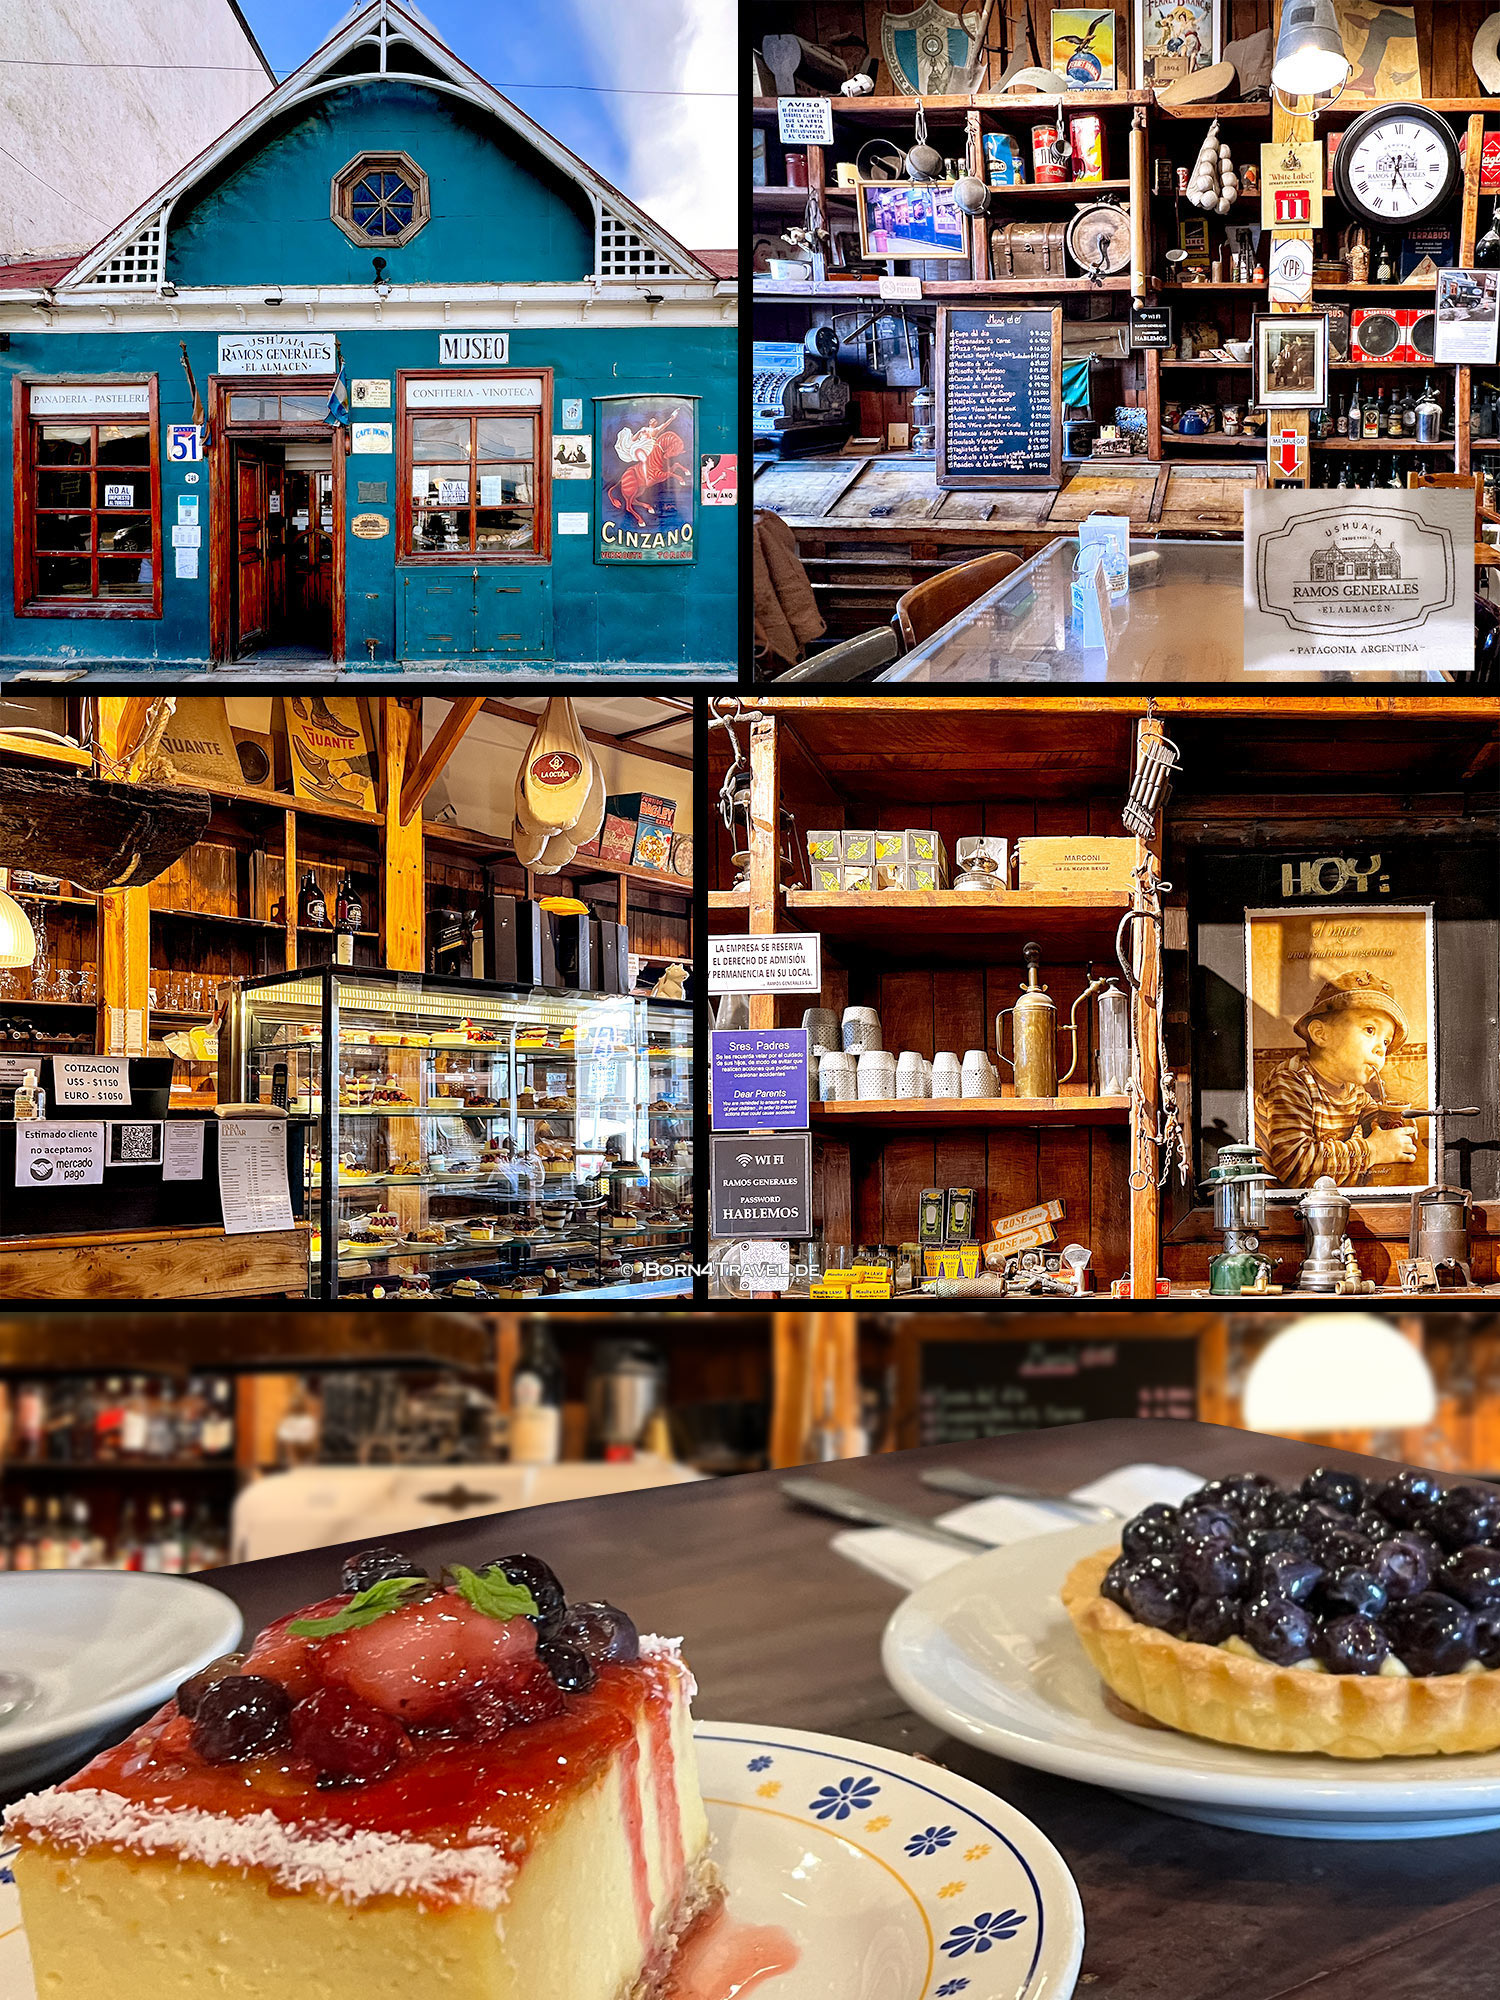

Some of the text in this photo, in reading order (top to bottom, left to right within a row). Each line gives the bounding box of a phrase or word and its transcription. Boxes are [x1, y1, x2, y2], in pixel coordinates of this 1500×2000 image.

[1281, 200, 1304, 220] 11
[1408, 231, 1450, 239] TERRABUSI
[1283, 260, 1300, 276] YPF
[248, 336, 304, 347] USHUAIA
[222, 347, 331, 361] RAMOS GENERALES
[444, 338, 504, 359] MUSEO
[261, 362, 308, 371] ALMACEN
[413, 388, 534, 398] CONFITERIA VINOTECA
[34, 395, 87, 404] PANADERIA
[173, 434, 197, 459] 51
[602, 521, 693, 549] CINZANO
[1325, 522, 1382, 537] USHUAIA
[1293, 584, 1419, 598] RAMOS GENERALES
[1297, 644, 1418, 655] PATAGONIA ARGENTINA
[302, 725, 355, 750] GUANTE
[161, 732, 223, 756] GUANTE
[640, 802, 674, 820] BAGLEY
[1282, 855, 1390, 897] HOY:
[1312, 920, 1328, 937] el
[726, 944, 759, 952] EMPRESA
[772, 943, 803, 951] RESERVA
[723, 957, 756, 965] DERECHO
[770, 953, 806, 964] ADMISIÓN
[712, 970, 764, 978] PERMANENCIA
[777, 969, 786, 977] SU
[788, 968, 813, 976] LOCAL.
[729, 1041, 790, 1051] Sres. Padres
[64, 1064, 119, 1073] COTIZACION
[93, 1078, 119, 1087] $1150
[64, 1092, 123, 1100] EURO $1050
[756, 1090, 786, 1098] Parents
[25, 1130, 66, 1138] Estimado
[44, 1146, 92, 1155] aceptamos
[56, 1158, 93, 1168] mercado
[755, 1155, 784, 1164] WI FI
[64, 1170, 84, 1180] pago
[723, 1207, 799, 1219] HABLEMOS
[1003, 1214, 1027, 1231] ROSE
[993, 1238, 1018, 1252] ROSE
